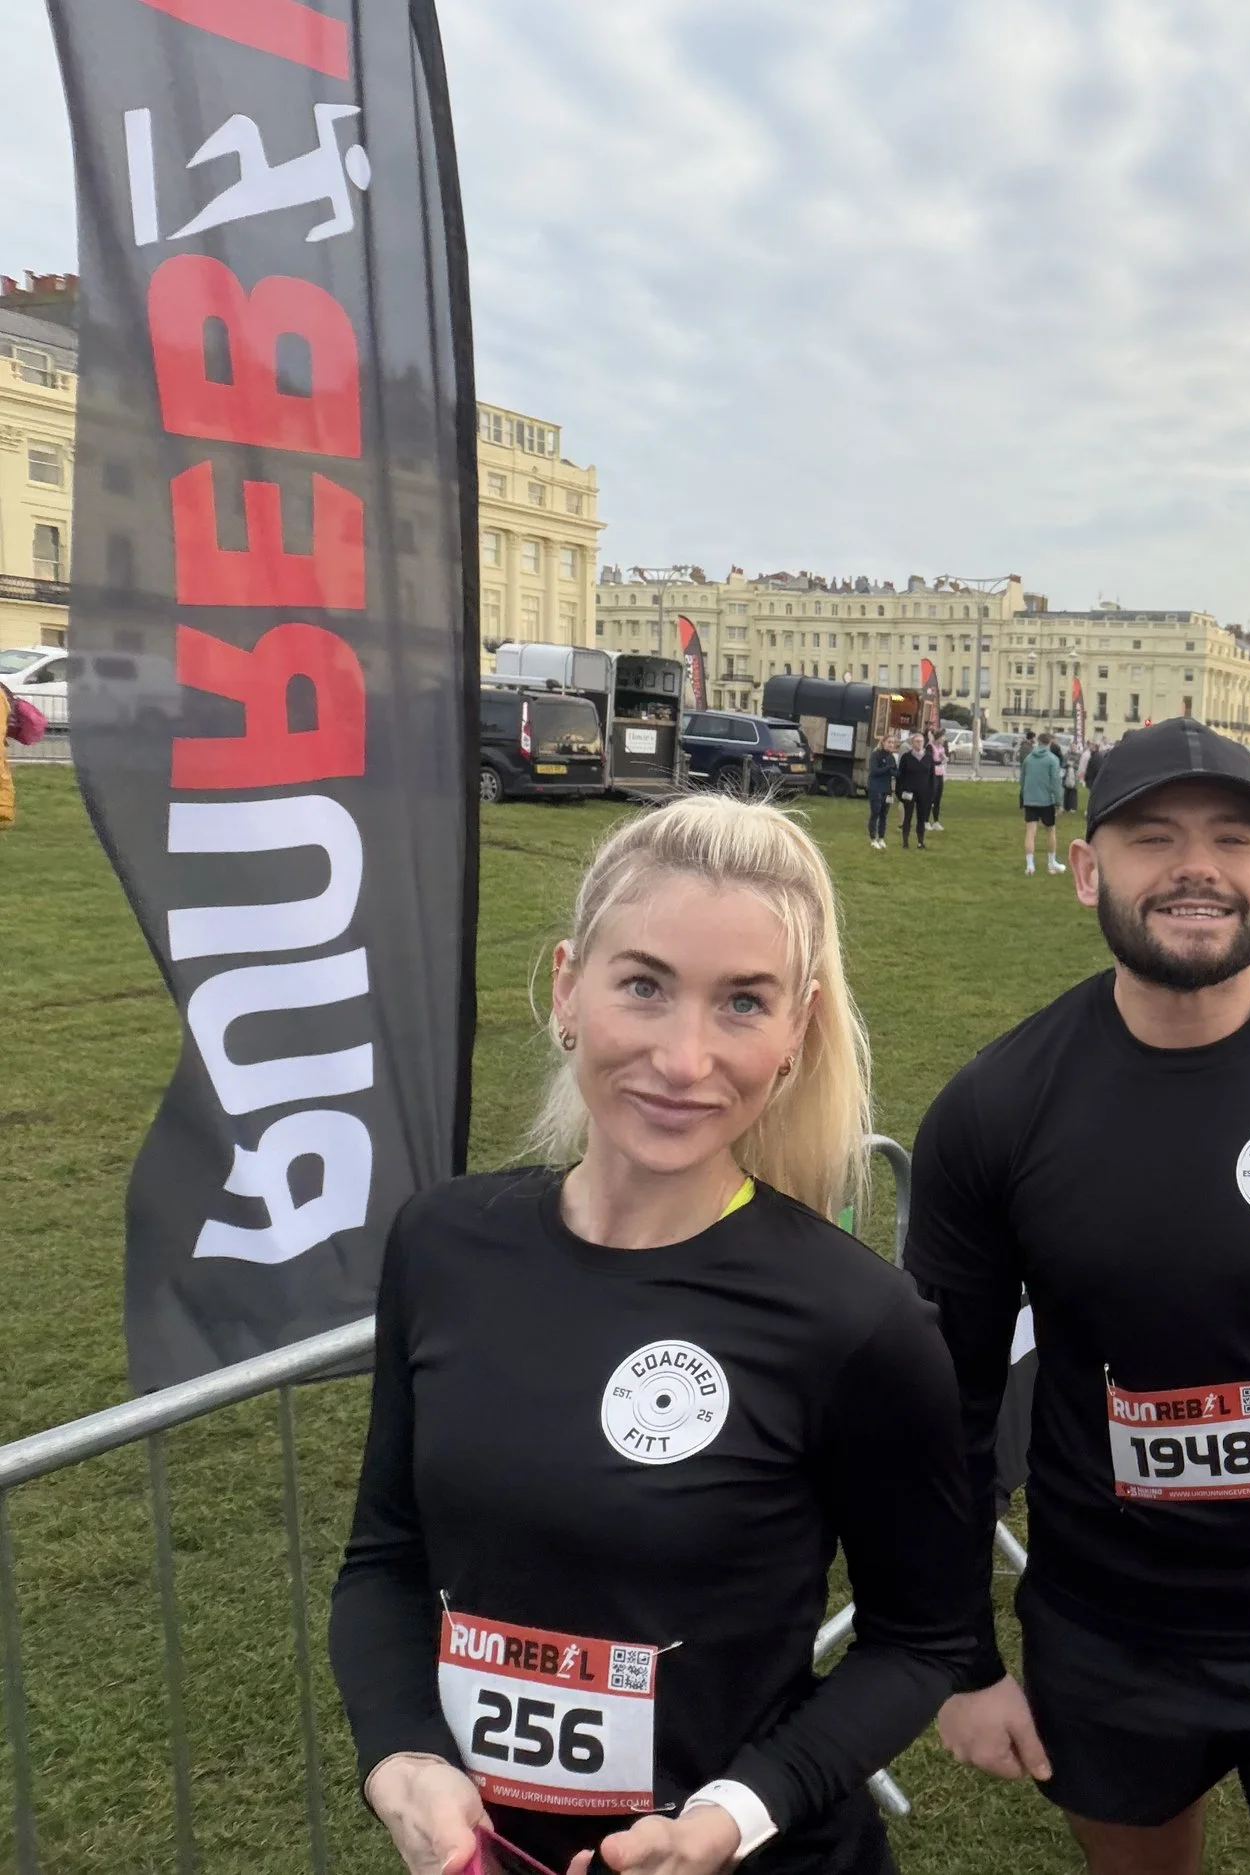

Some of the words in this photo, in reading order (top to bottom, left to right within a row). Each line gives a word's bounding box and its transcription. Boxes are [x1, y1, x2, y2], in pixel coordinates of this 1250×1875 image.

[630, 1350, 717, 1396] COACHED
[612, 1386, 633, 1400] EST.
[696, 1409, 714, 1423] 25
[623, 1427, 671, 1453] FITT
[471, 1688, 606, 1775] 256
[492, 1784, 651, 1808] WWW.UKRUNNINGEVENTS.COUK
